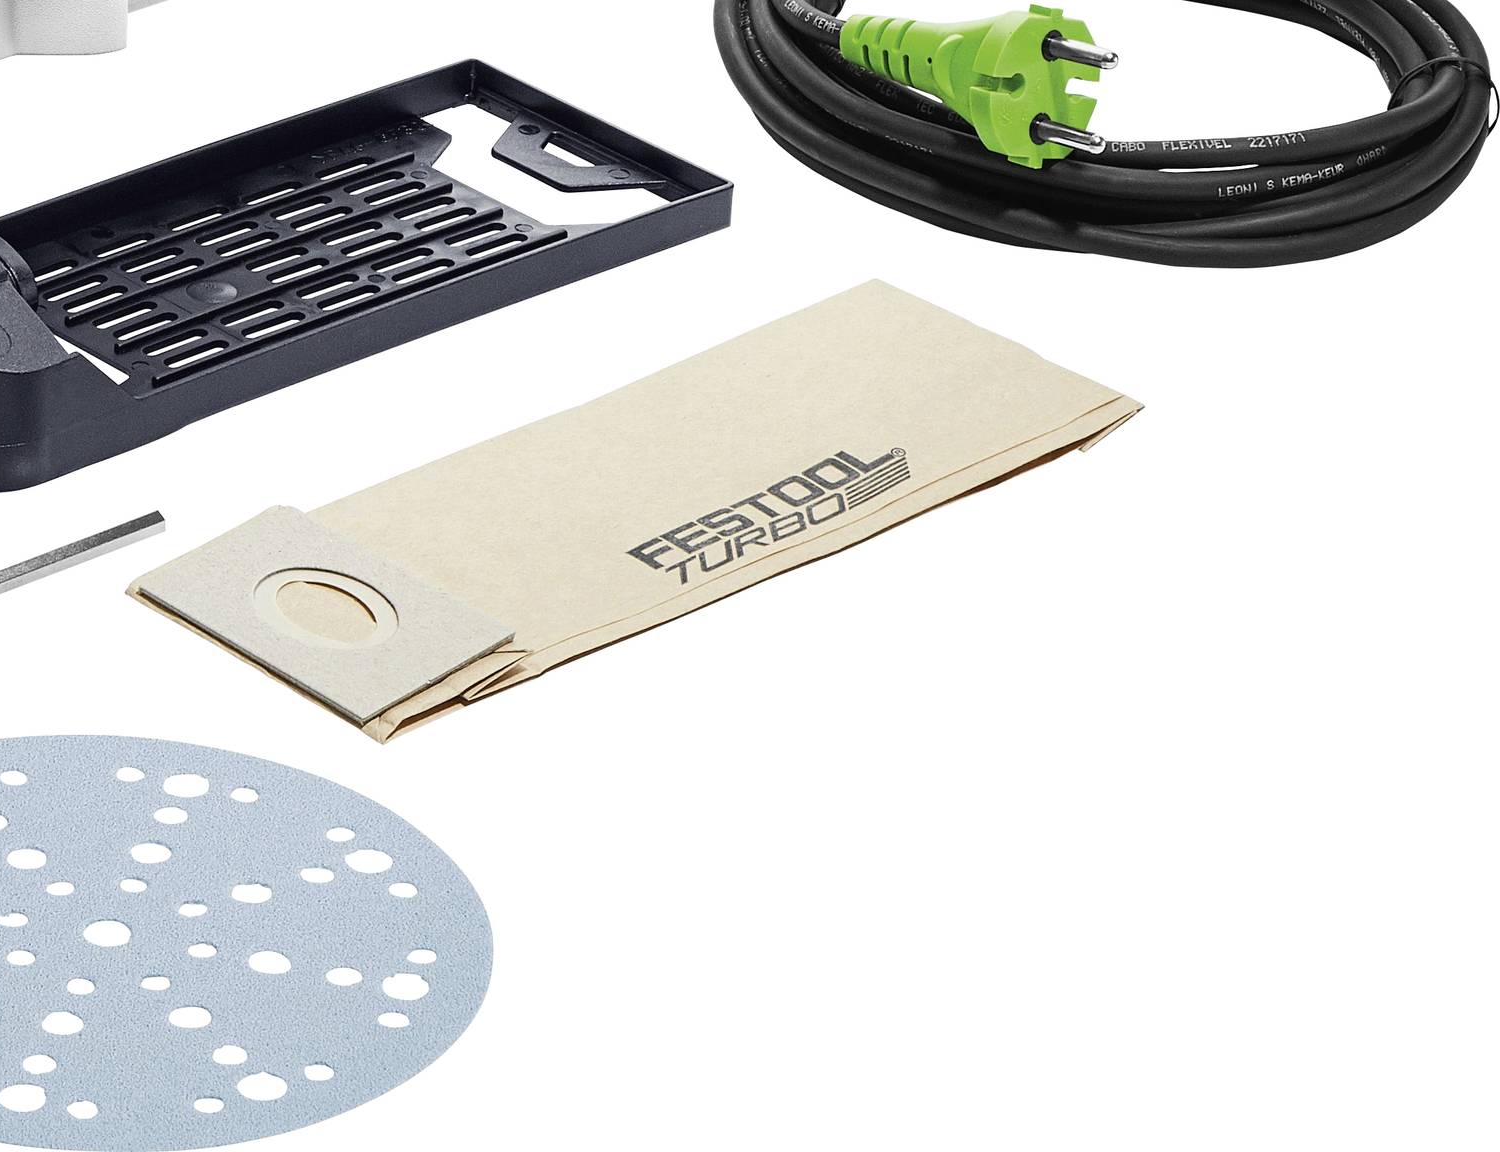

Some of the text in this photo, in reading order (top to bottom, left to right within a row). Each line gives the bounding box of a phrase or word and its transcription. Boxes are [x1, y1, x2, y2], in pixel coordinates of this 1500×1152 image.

[1111, 132, 1307, 152] CABO FLEXIVEL 2217171
[1217, 182, 1258, 198] LEONI
[1266, 179, 1275, 190] S
[1281, 162, 1345, 188] KEMA-KEUR
[665, 492, 846, 586] TURBO
